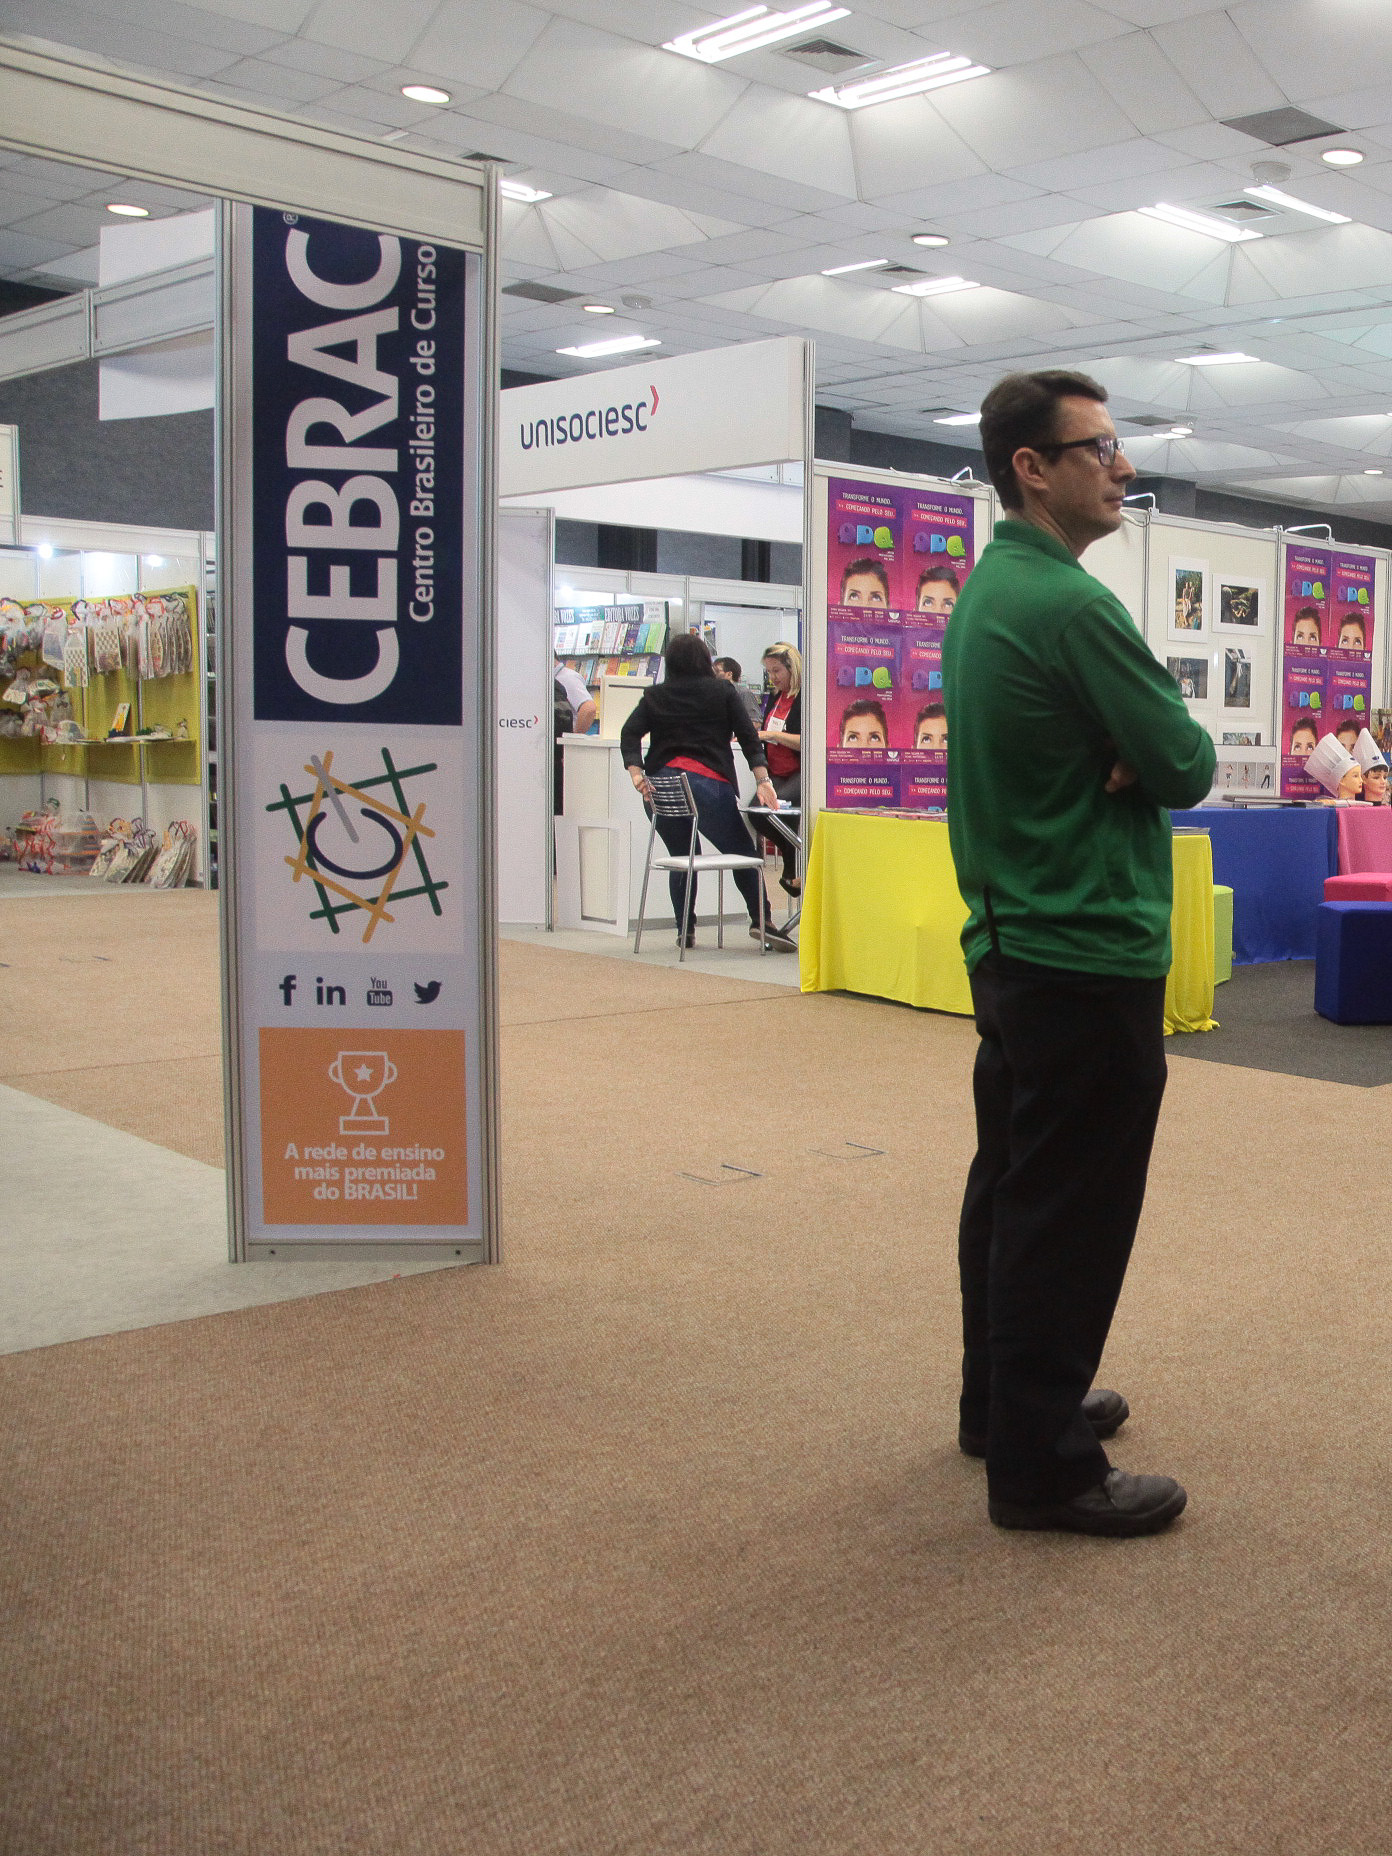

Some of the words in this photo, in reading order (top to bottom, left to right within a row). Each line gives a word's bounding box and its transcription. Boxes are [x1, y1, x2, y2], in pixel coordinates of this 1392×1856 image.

[410, 244, 437, 331] Curso
[409, 339, 436, 376] de
[409, 384, 435, 517] Brasileiro
[285, 227, 402, 705] CEBRAC
[409, 526, 435, 622] Centro
[499, 718, 532, 728] ciesc
[370, 977, 388, 989] You
[369, 992, 391, 1005] Tube
[284, 1143, 299, 1160] A
[303, 1143, 348, 1160] rede
[352, 1143, 377, 1160] de
[381, 1144, 445, 1160] ensino
[294, 1163, 340, 1180] mais
[344, 1163, 436, 1184] premiada
[313, 1182, 340, 1200] do
[344, 1183, 418, 1200] BRASIL!
